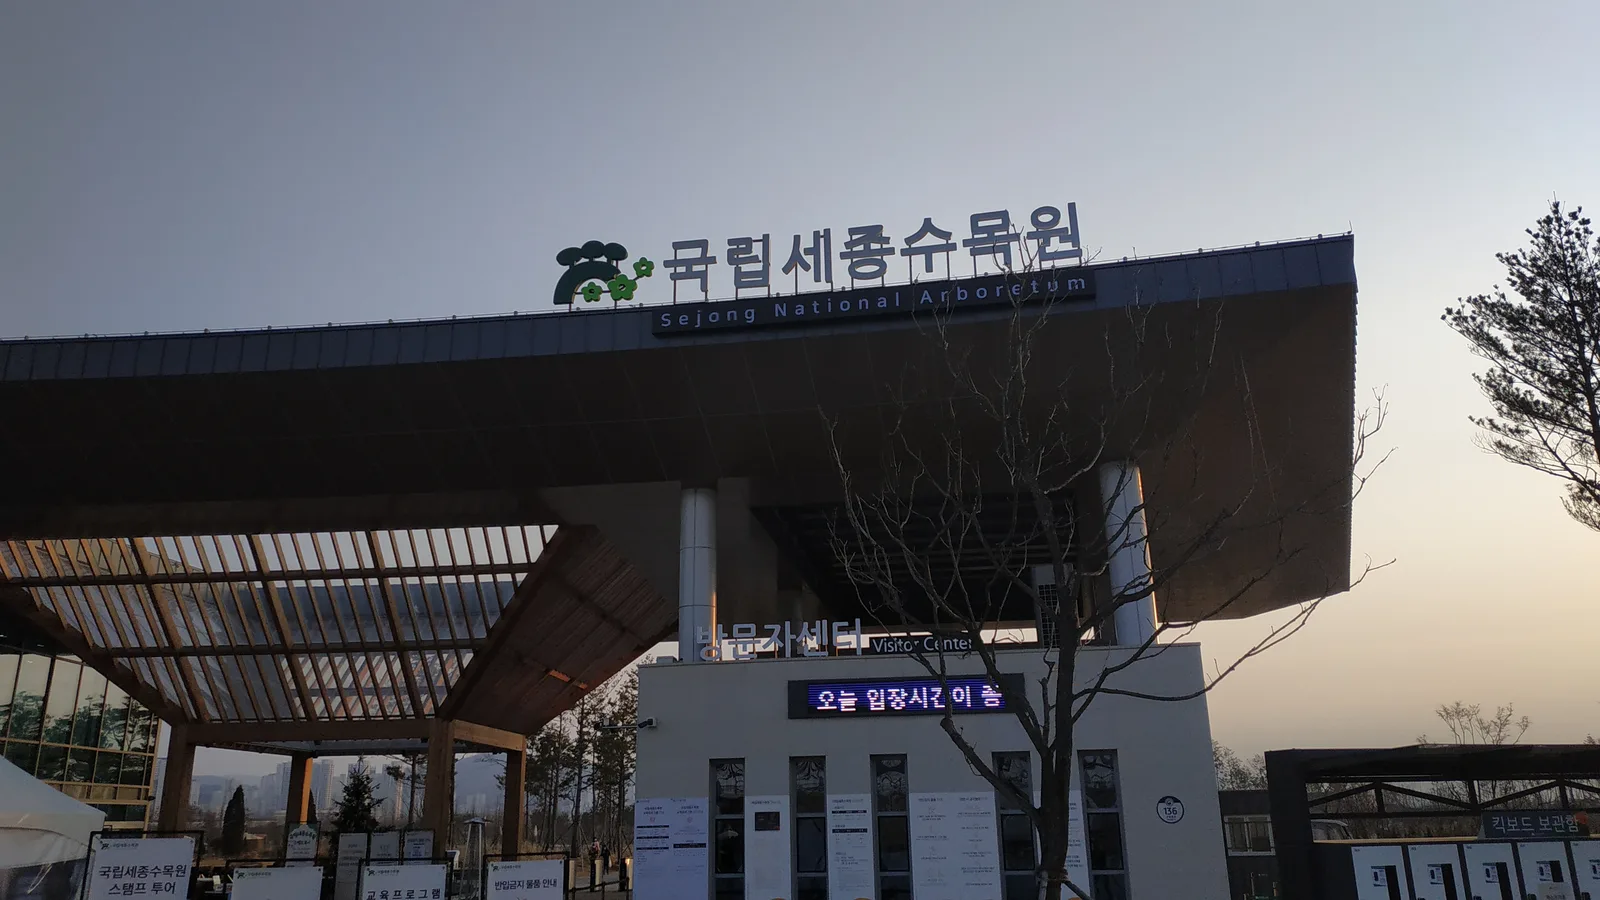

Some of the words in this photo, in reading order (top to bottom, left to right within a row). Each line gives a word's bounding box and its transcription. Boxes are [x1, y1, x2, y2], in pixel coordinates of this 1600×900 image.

[663, 201, 1083, 294] 국립세종수목원
[660, 305, 757, 328] Sejong
[775, 291, 901, 317] National
[919, 277, 1087, 305] Arboretum
[696, 617, 862, 661] 방문자센터
[816, 690, 858, 712] 오늘
[1163, 806, 1178, 816] 136
[1491, 815, 1535, 834] 킥보드
[1538, 814, 1579, 833] 보관함
[98, 863, 188, 880] 국립세종수목원
[108, 882, 148, 896] 스탬프
[150, 881, 177, 895] 투어
[494, 879, 525, 891] 반입금지
[542, 877, 558, 889] 안내
[366, 888, 441, 900] 교육프로그램
